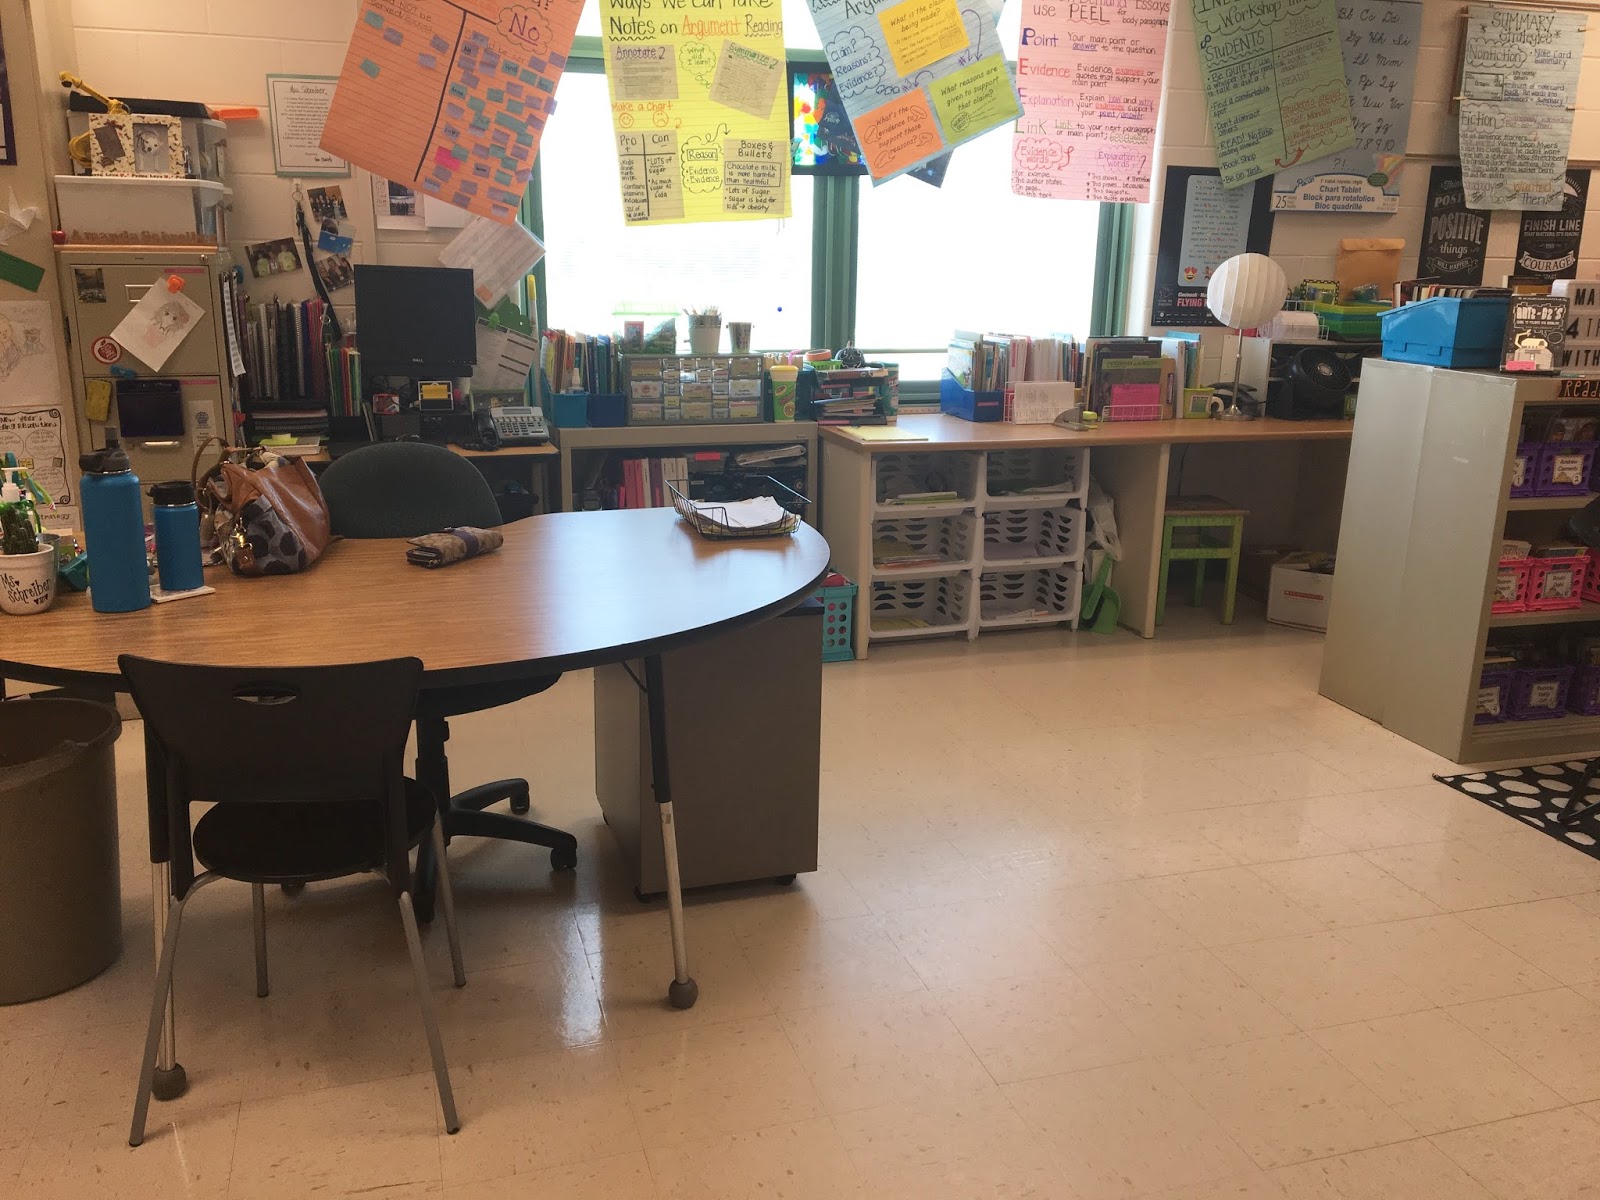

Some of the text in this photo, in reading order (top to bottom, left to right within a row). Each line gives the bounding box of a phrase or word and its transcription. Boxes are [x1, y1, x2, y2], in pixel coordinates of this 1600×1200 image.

[1034, 3, 1110, 23] use PEEL
[1117, 8, 1127, 16] for
[1219, 1, 1281, 28] Workshop
[1360, 9, 1375, 22] Cc
[609, 13, 783, 39] Notes on Argument Reading
[1123, 16, 1139, 25] body
[1491, 11, 1555, 33] SUMMARY
[1022, 27, 1059, 48] Point
[1067, 32, 1086, 41] Your
[1090, 36, 1108, 44] main
[1109, 36, 1127, 46] point
[1499, 29, 1553, 47] Strategies
[616, 45, 657, 59] Annotate
[830, 38, 857, 62] Claim?
[1073, 43, 1098, 51] answer
[1112, 44, 1124, 53] the
[1205, 30, 1265, 62] STUDENTS
[728, 42, 770, 66] Summarize
[958, 48, 973, 67] #2
[1469, 44, 1522, 63] Nonfiction
[692, 57, 711, 66] learn?
[834, 53, 874, 77] Reasons?
[1019, 58, 1071, 78] Evidence
[838, 66, 879, 93] Evidence?
[941, 66, 998, 96] What reasons are
[1076, 72, 1098, 82] quotes
[1115, 75, 1141, 84] support
[1090, 80, 1107, 88] point
[1211, 72, 1224, 82] Be
[946, 77, 999, 107] given to support
[1018, 88, 1074, 109] Explanation
[1080, 93, 1105, 102] Explain
[612, 102, 634, 111] Make
[638, 103, 644, 111] a
[957, 89, 994, 112] that claim?
[1076, 101, 1093, 111] your
[1127, 105, 1154, 113] support
[876, 105, 909, 126] What's the
[1080, 109, 1096, 118] your
[1461, 110, 1496, 128] Fiction
[878, 115, 914, 137] evidence to
[1105, 125, 1121, 133] next
[620, 134, 669, 146] Pro Con
[878, 123, 921, 149] support those
[1220, 132, 1245, 149] READ!
[741, 140, 767, 150] Boxes
[890, 136, 918, 154] reasons?
[1021, 146, 1059, 158] Evidence
[688, 149, 718, 160] Reason
[738, 149, 772, 159] Bullets
[689, 166, 718, 175] Evidence
[727, 162, 759, 170] Chocolate
[690, 175, 720, 184] Evidence
[1319, 185, 1362, 193] Chart Tablet
[1275, 195, 1288, 209] 25
[1303, 193, 1323, 201] Block
[1314, 202, 1331, 210] Bloc
[1428, 211, 1485, 245] POSITIVE
[1523, 219, 1582, 232] FINISH LINE
[1440, 241, 1469, 259] things
[1523, 256, 1572, 271] COURAGE
[1177, 298, 1203, 307] FLYING
[1574, 475, 1580, 483] 2
[8, 578, 51, 605] Schreiber
[1510, 592, 1515, 600] 5
